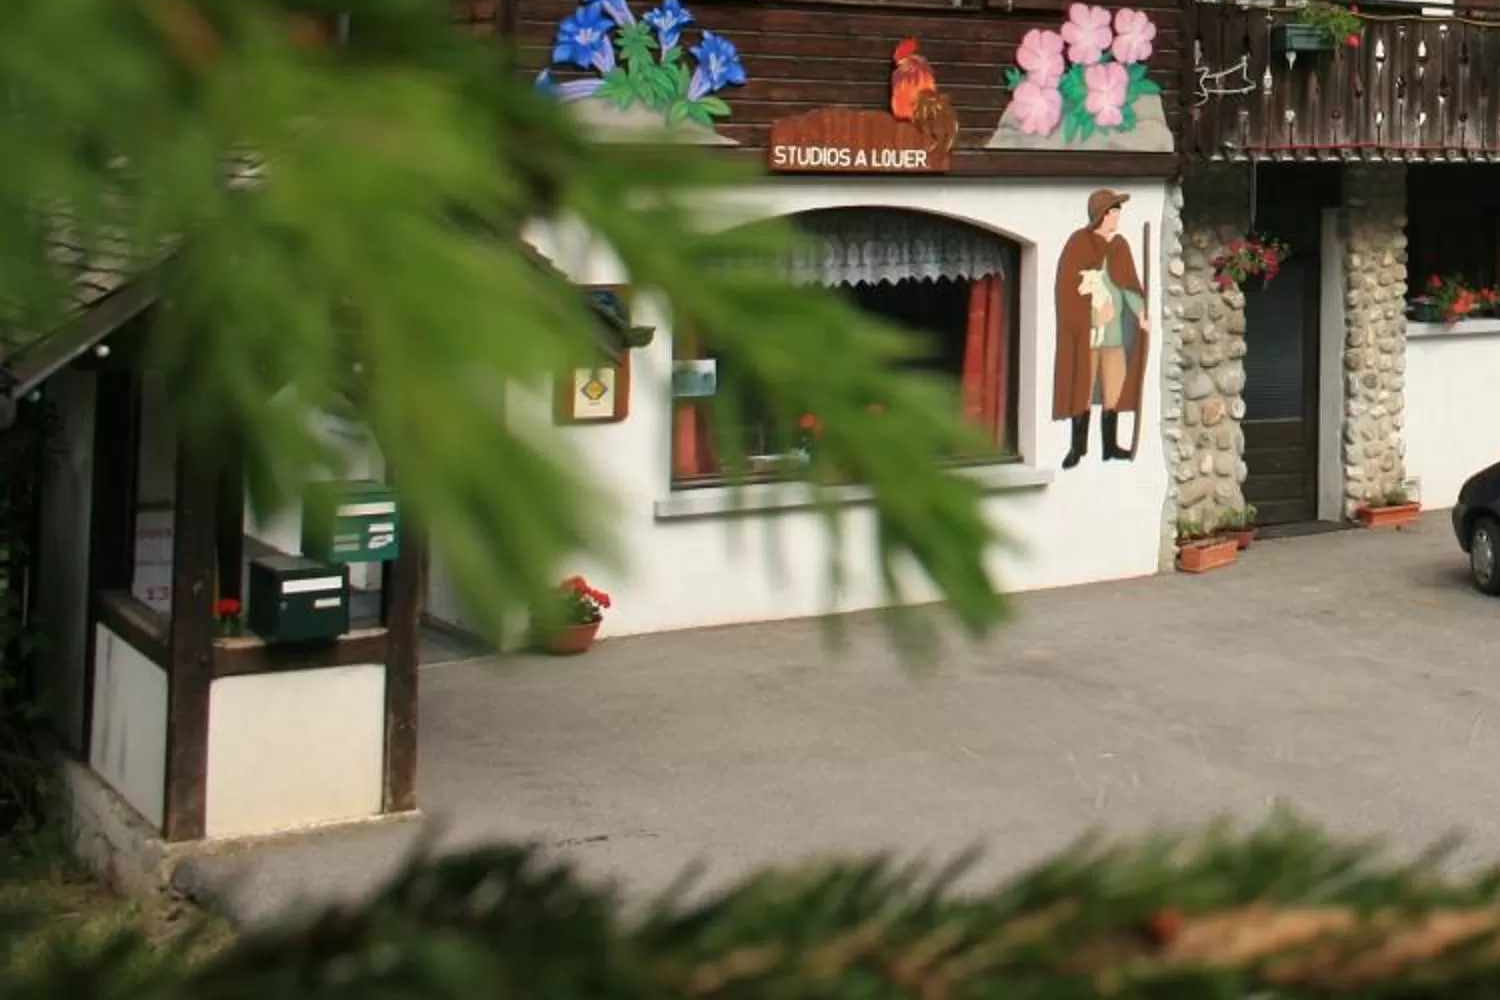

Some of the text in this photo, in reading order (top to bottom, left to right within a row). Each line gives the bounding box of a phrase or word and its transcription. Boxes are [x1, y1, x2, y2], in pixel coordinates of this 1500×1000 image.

[774, 146, 927, 168] STUDIOS A LOUER
